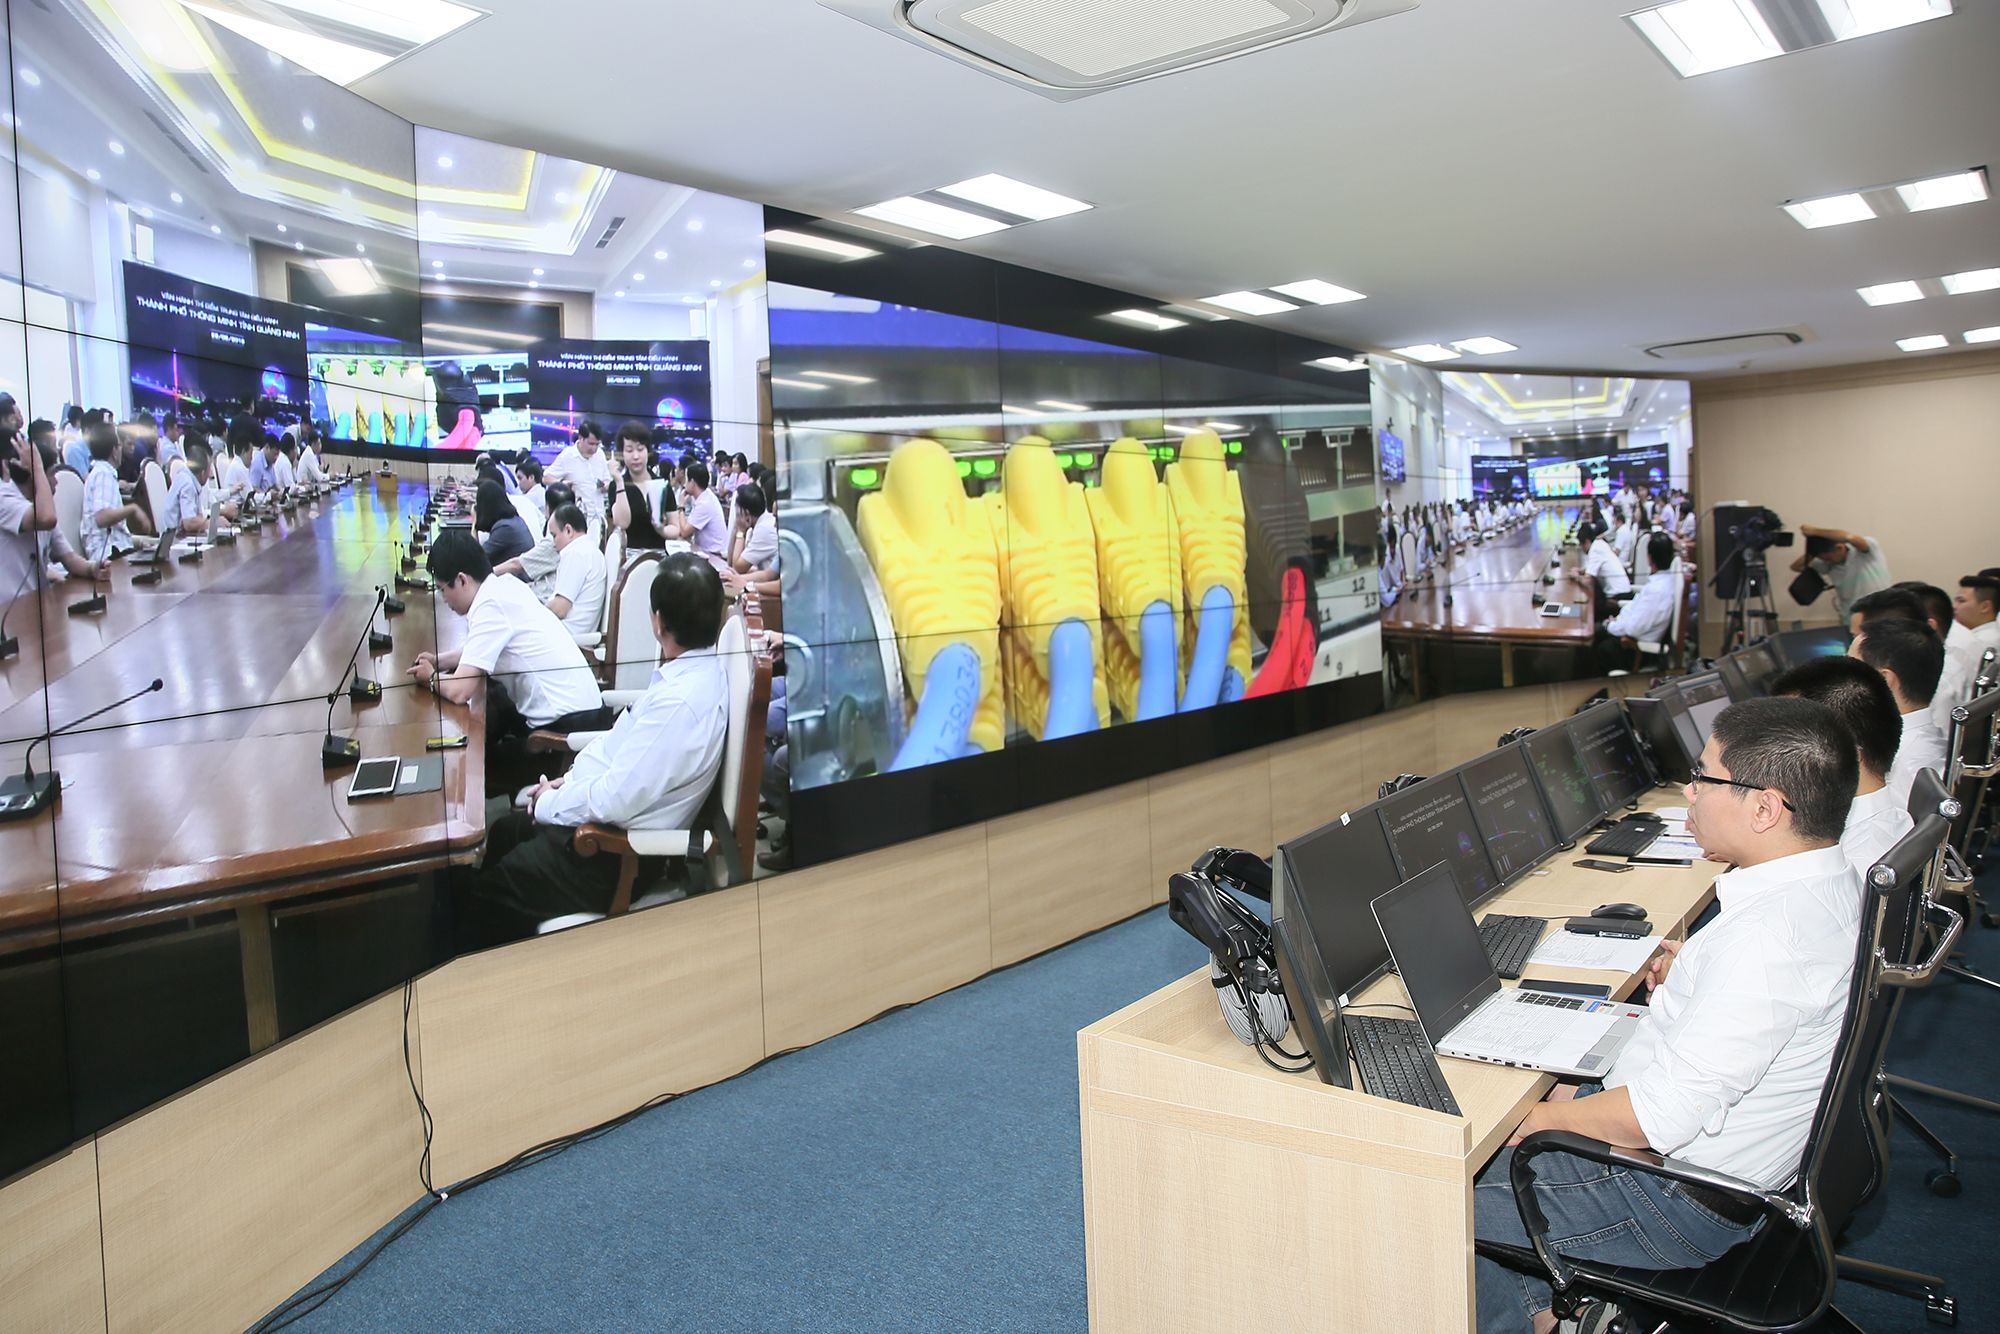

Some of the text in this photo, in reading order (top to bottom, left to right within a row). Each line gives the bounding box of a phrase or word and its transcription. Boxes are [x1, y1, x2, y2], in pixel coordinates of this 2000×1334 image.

[1352, 576, 1366, 593] 12
[1364, 592, 1377, 609] 13
[1323, 653, 1330, 668] 4
